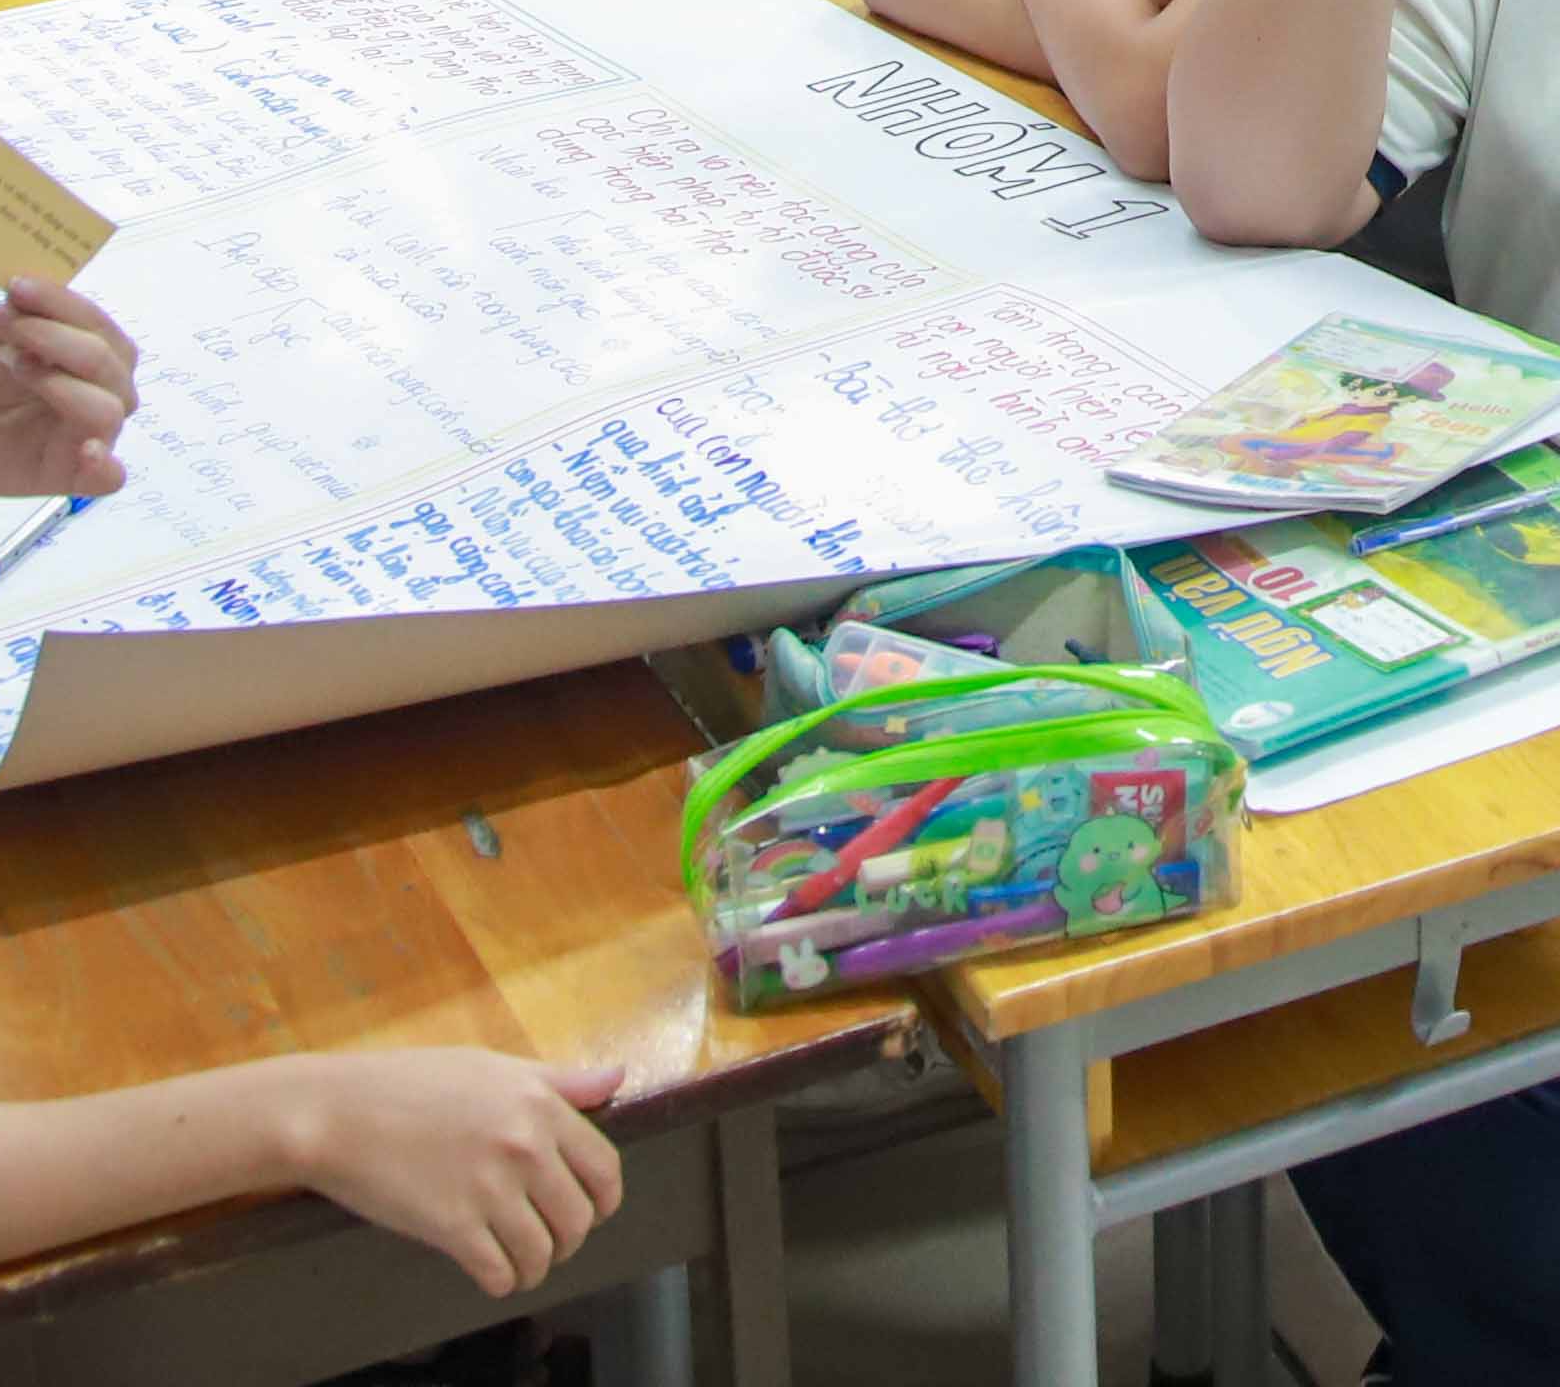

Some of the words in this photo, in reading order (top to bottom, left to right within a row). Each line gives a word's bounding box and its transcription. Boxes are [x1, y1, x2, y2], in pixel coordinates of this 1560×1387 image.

[667, 139, 701, 153] ra
[806, 60, 1106, 200] NHÓM
[1039, 200, 1169, 240] 1
[592, 166, 663, 203] trong
[1252, 565, 1320, 604] 10
